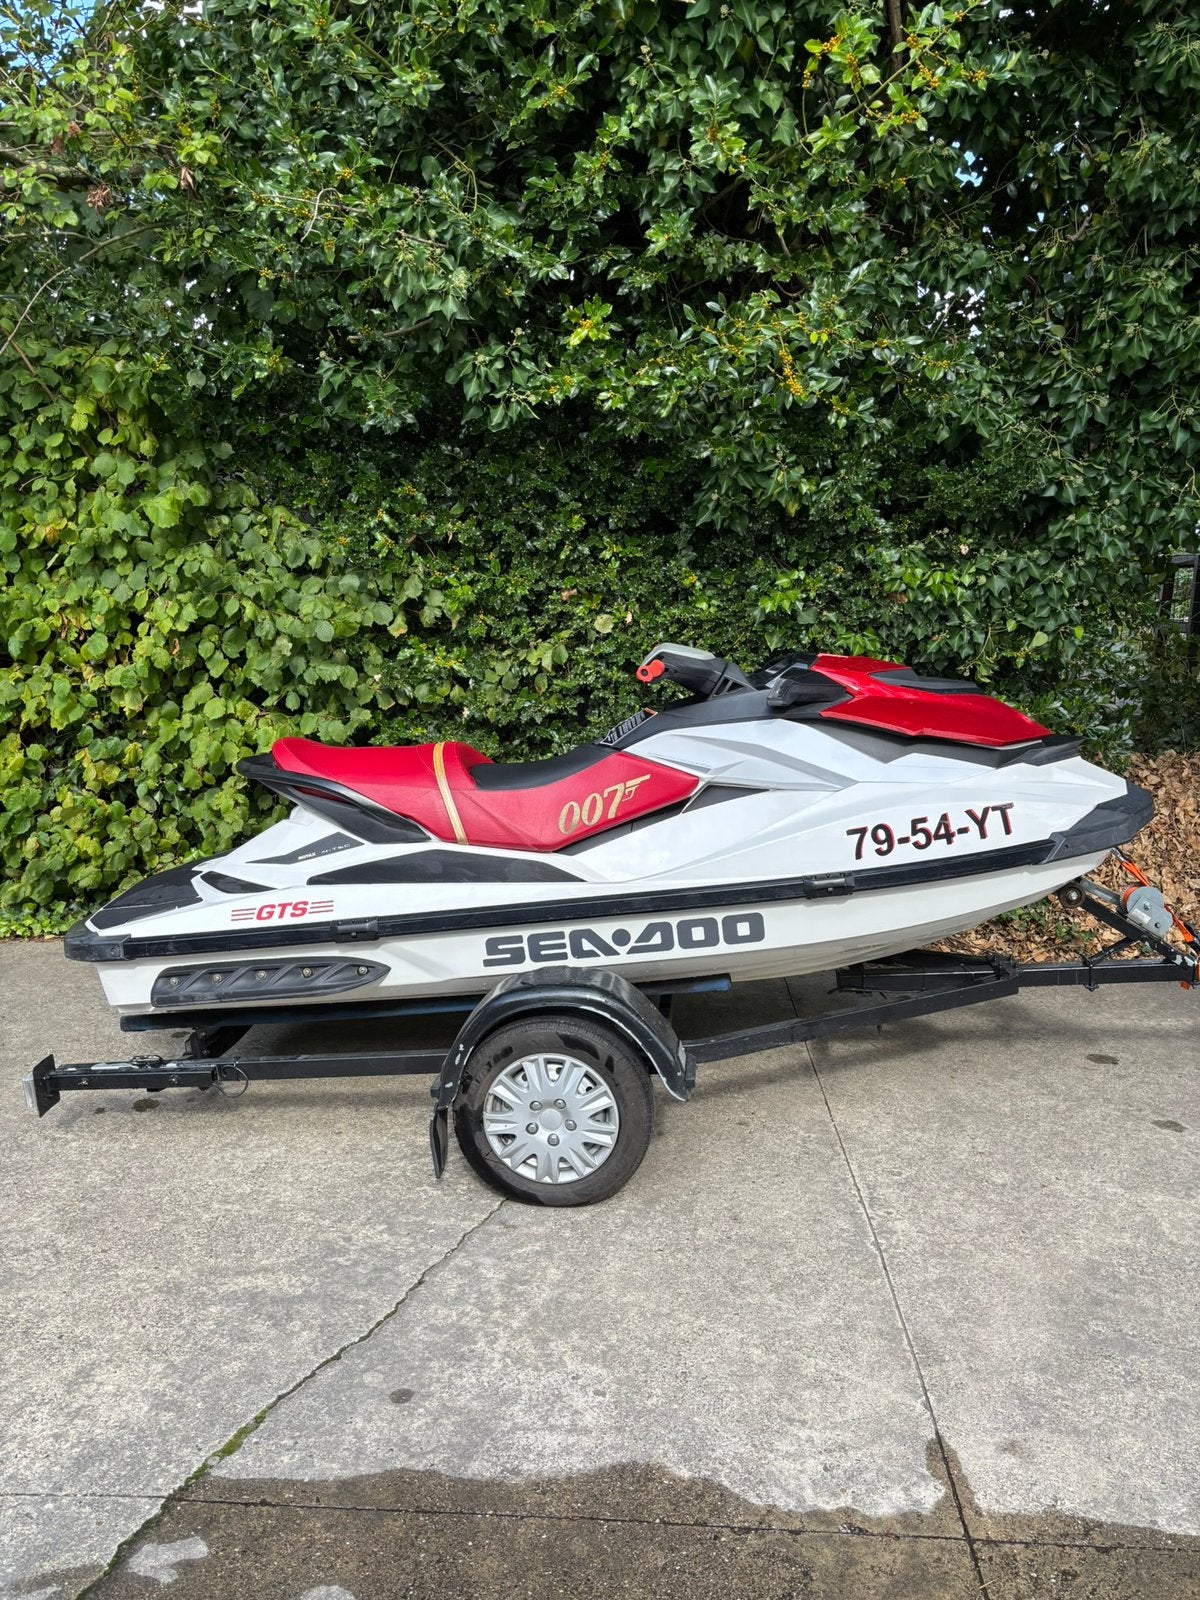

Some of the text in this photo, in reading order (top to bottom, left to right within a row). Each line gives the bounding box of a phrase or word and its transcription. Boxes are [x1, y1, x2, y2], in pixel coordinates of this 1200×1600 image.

[558, 783, 625, 835] 007
[846, 802, 1014, 860] 79-54-YT
[256, 900, 309, 921] GTS
